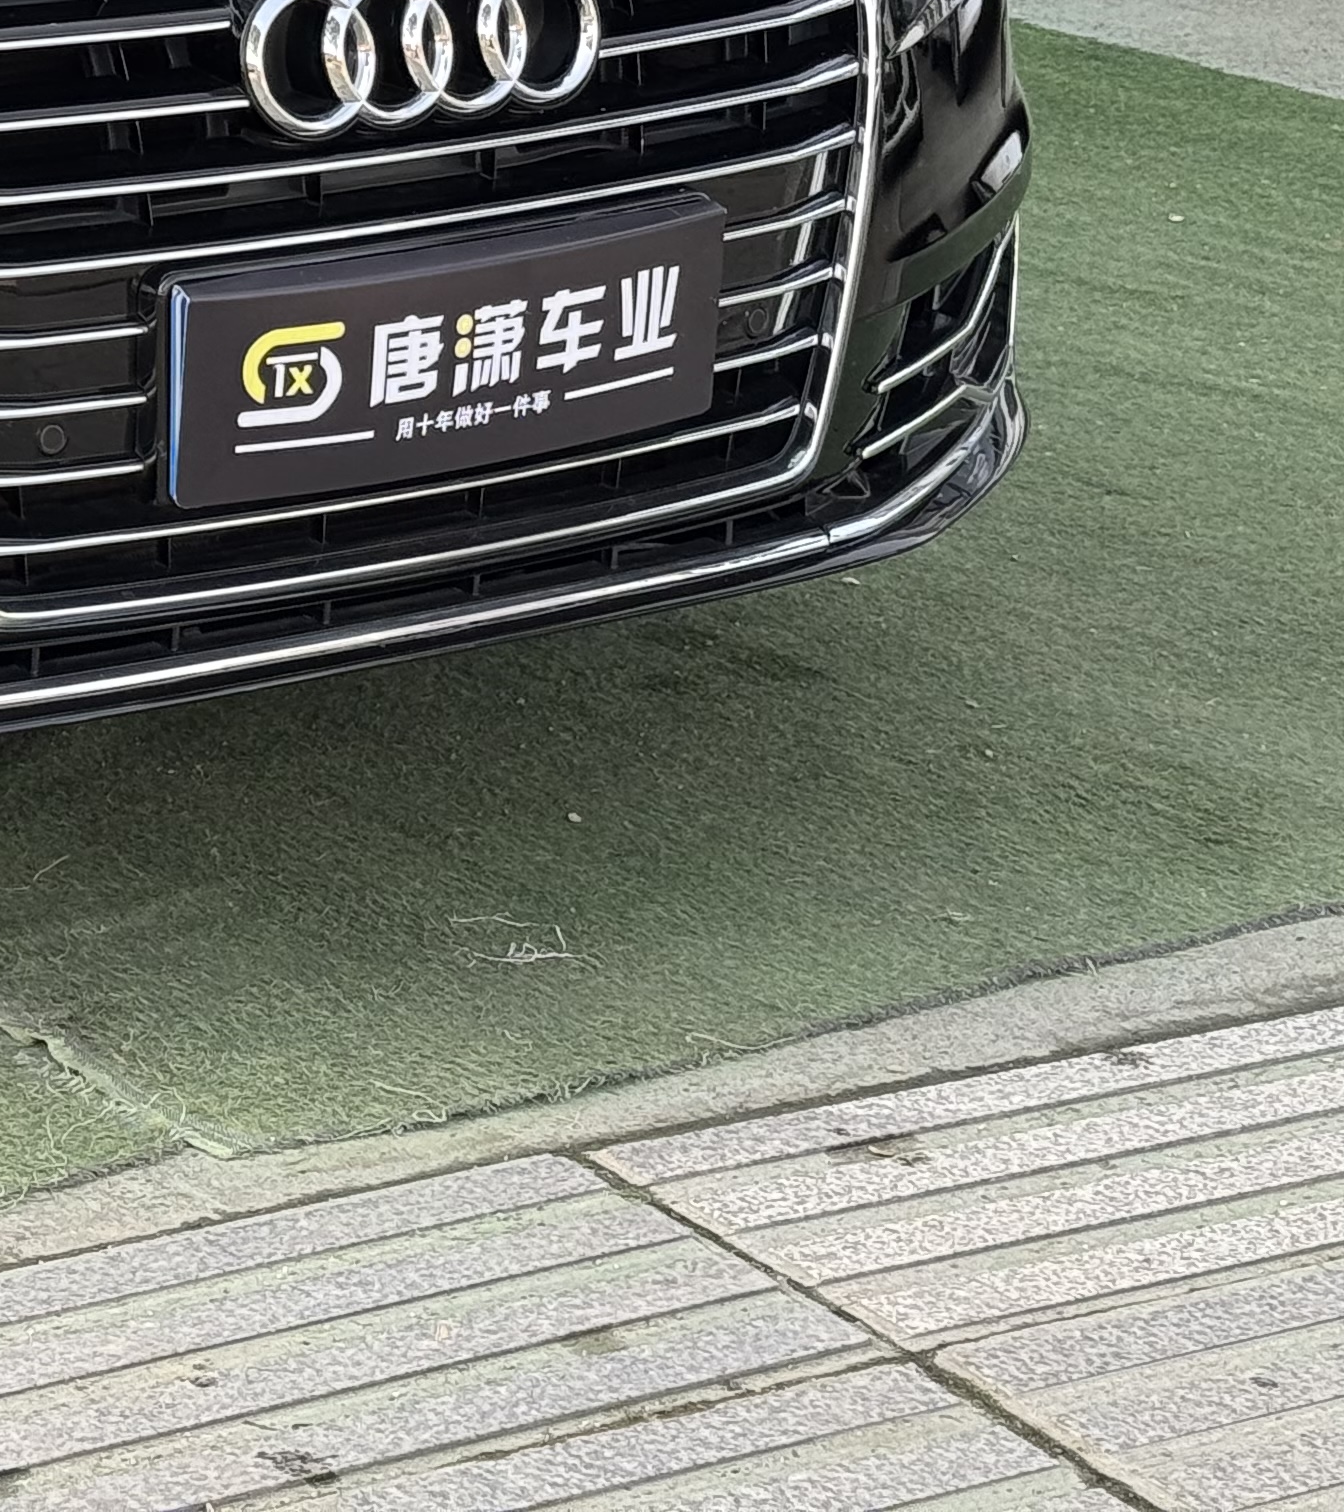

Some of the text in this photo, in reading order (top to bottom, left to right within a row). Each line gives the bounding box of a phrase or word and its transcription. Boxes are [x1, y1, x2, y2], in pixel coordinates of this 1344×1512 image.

[369, 265, 681, 408] 唐潇车业
[395, 389, 552, 442] 用十年做好一件事
